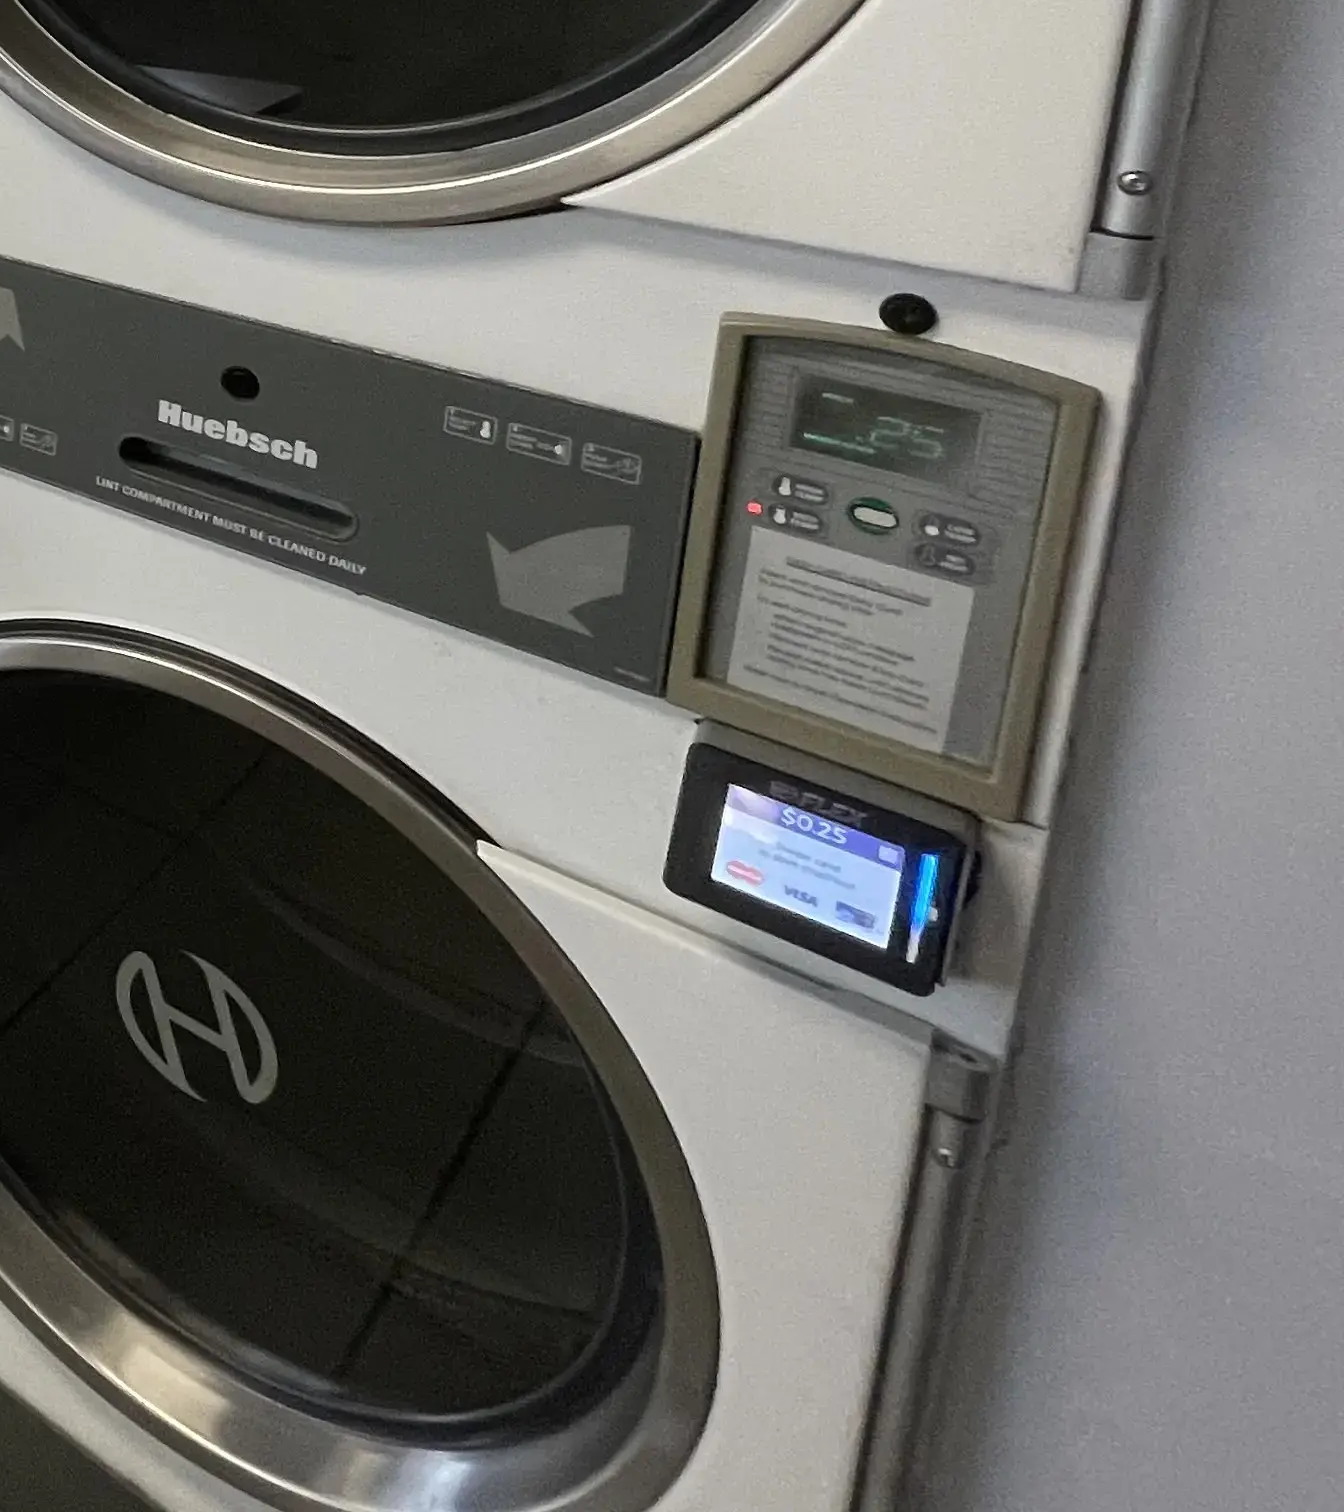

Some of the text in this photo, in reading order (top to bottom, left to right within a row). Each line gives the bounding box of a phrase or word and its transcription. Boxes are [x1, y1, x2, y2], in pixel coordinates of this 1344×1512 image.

[157, 399, 318, 469] Huebsch
[96, 475, 368, 575] LINT COMPARTMENT MUST BE CLEANED DAILY
[780, 805, 848, 844] $0.25
[783, 884, 819, 909] VISA
